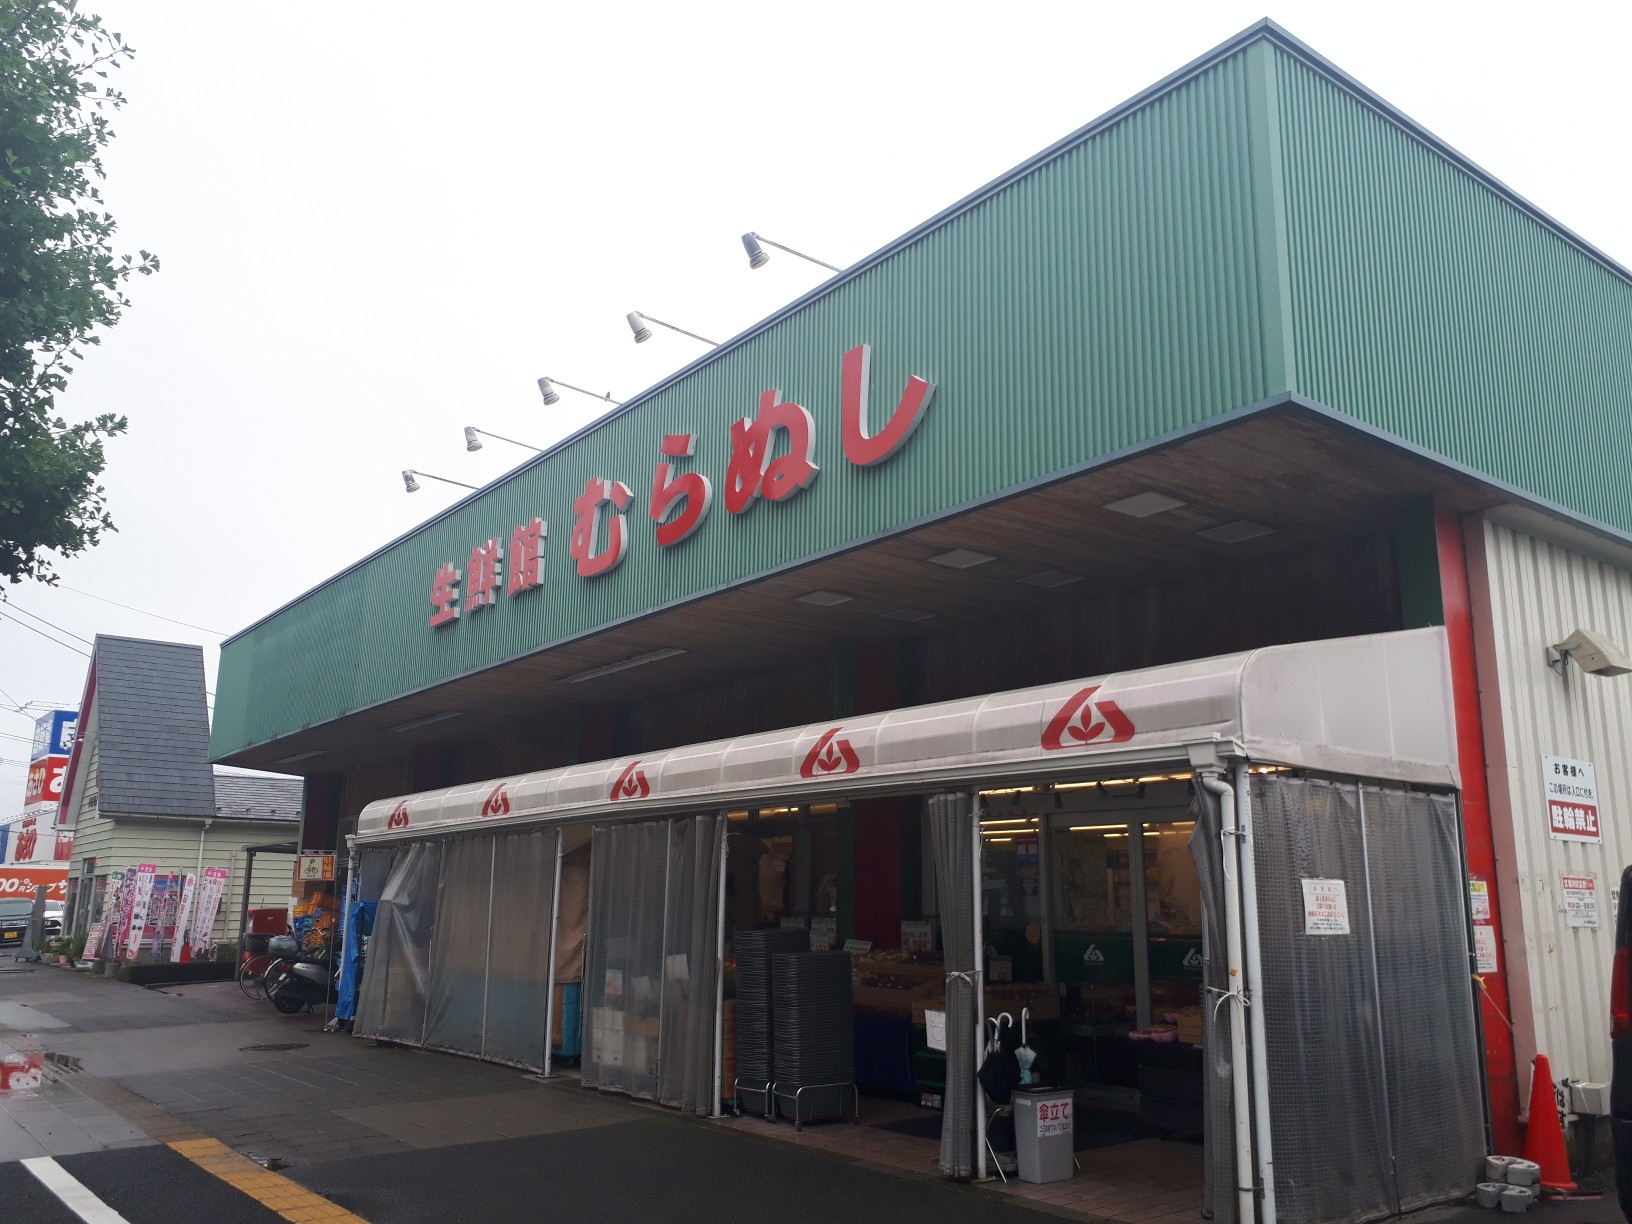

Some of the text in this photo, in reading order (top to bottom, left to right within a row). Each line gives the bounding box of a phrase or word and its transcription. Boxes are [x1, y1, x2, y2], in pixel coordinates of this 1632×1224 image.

[429, 343, 937, 628] 生鮮館 むらぬし
[1553, 762, 1585, 777] お客様へ
[1551, 805, 1596, 831] 駐輪禁止
[1039, 1102, 1069, 1122] 傘立て
